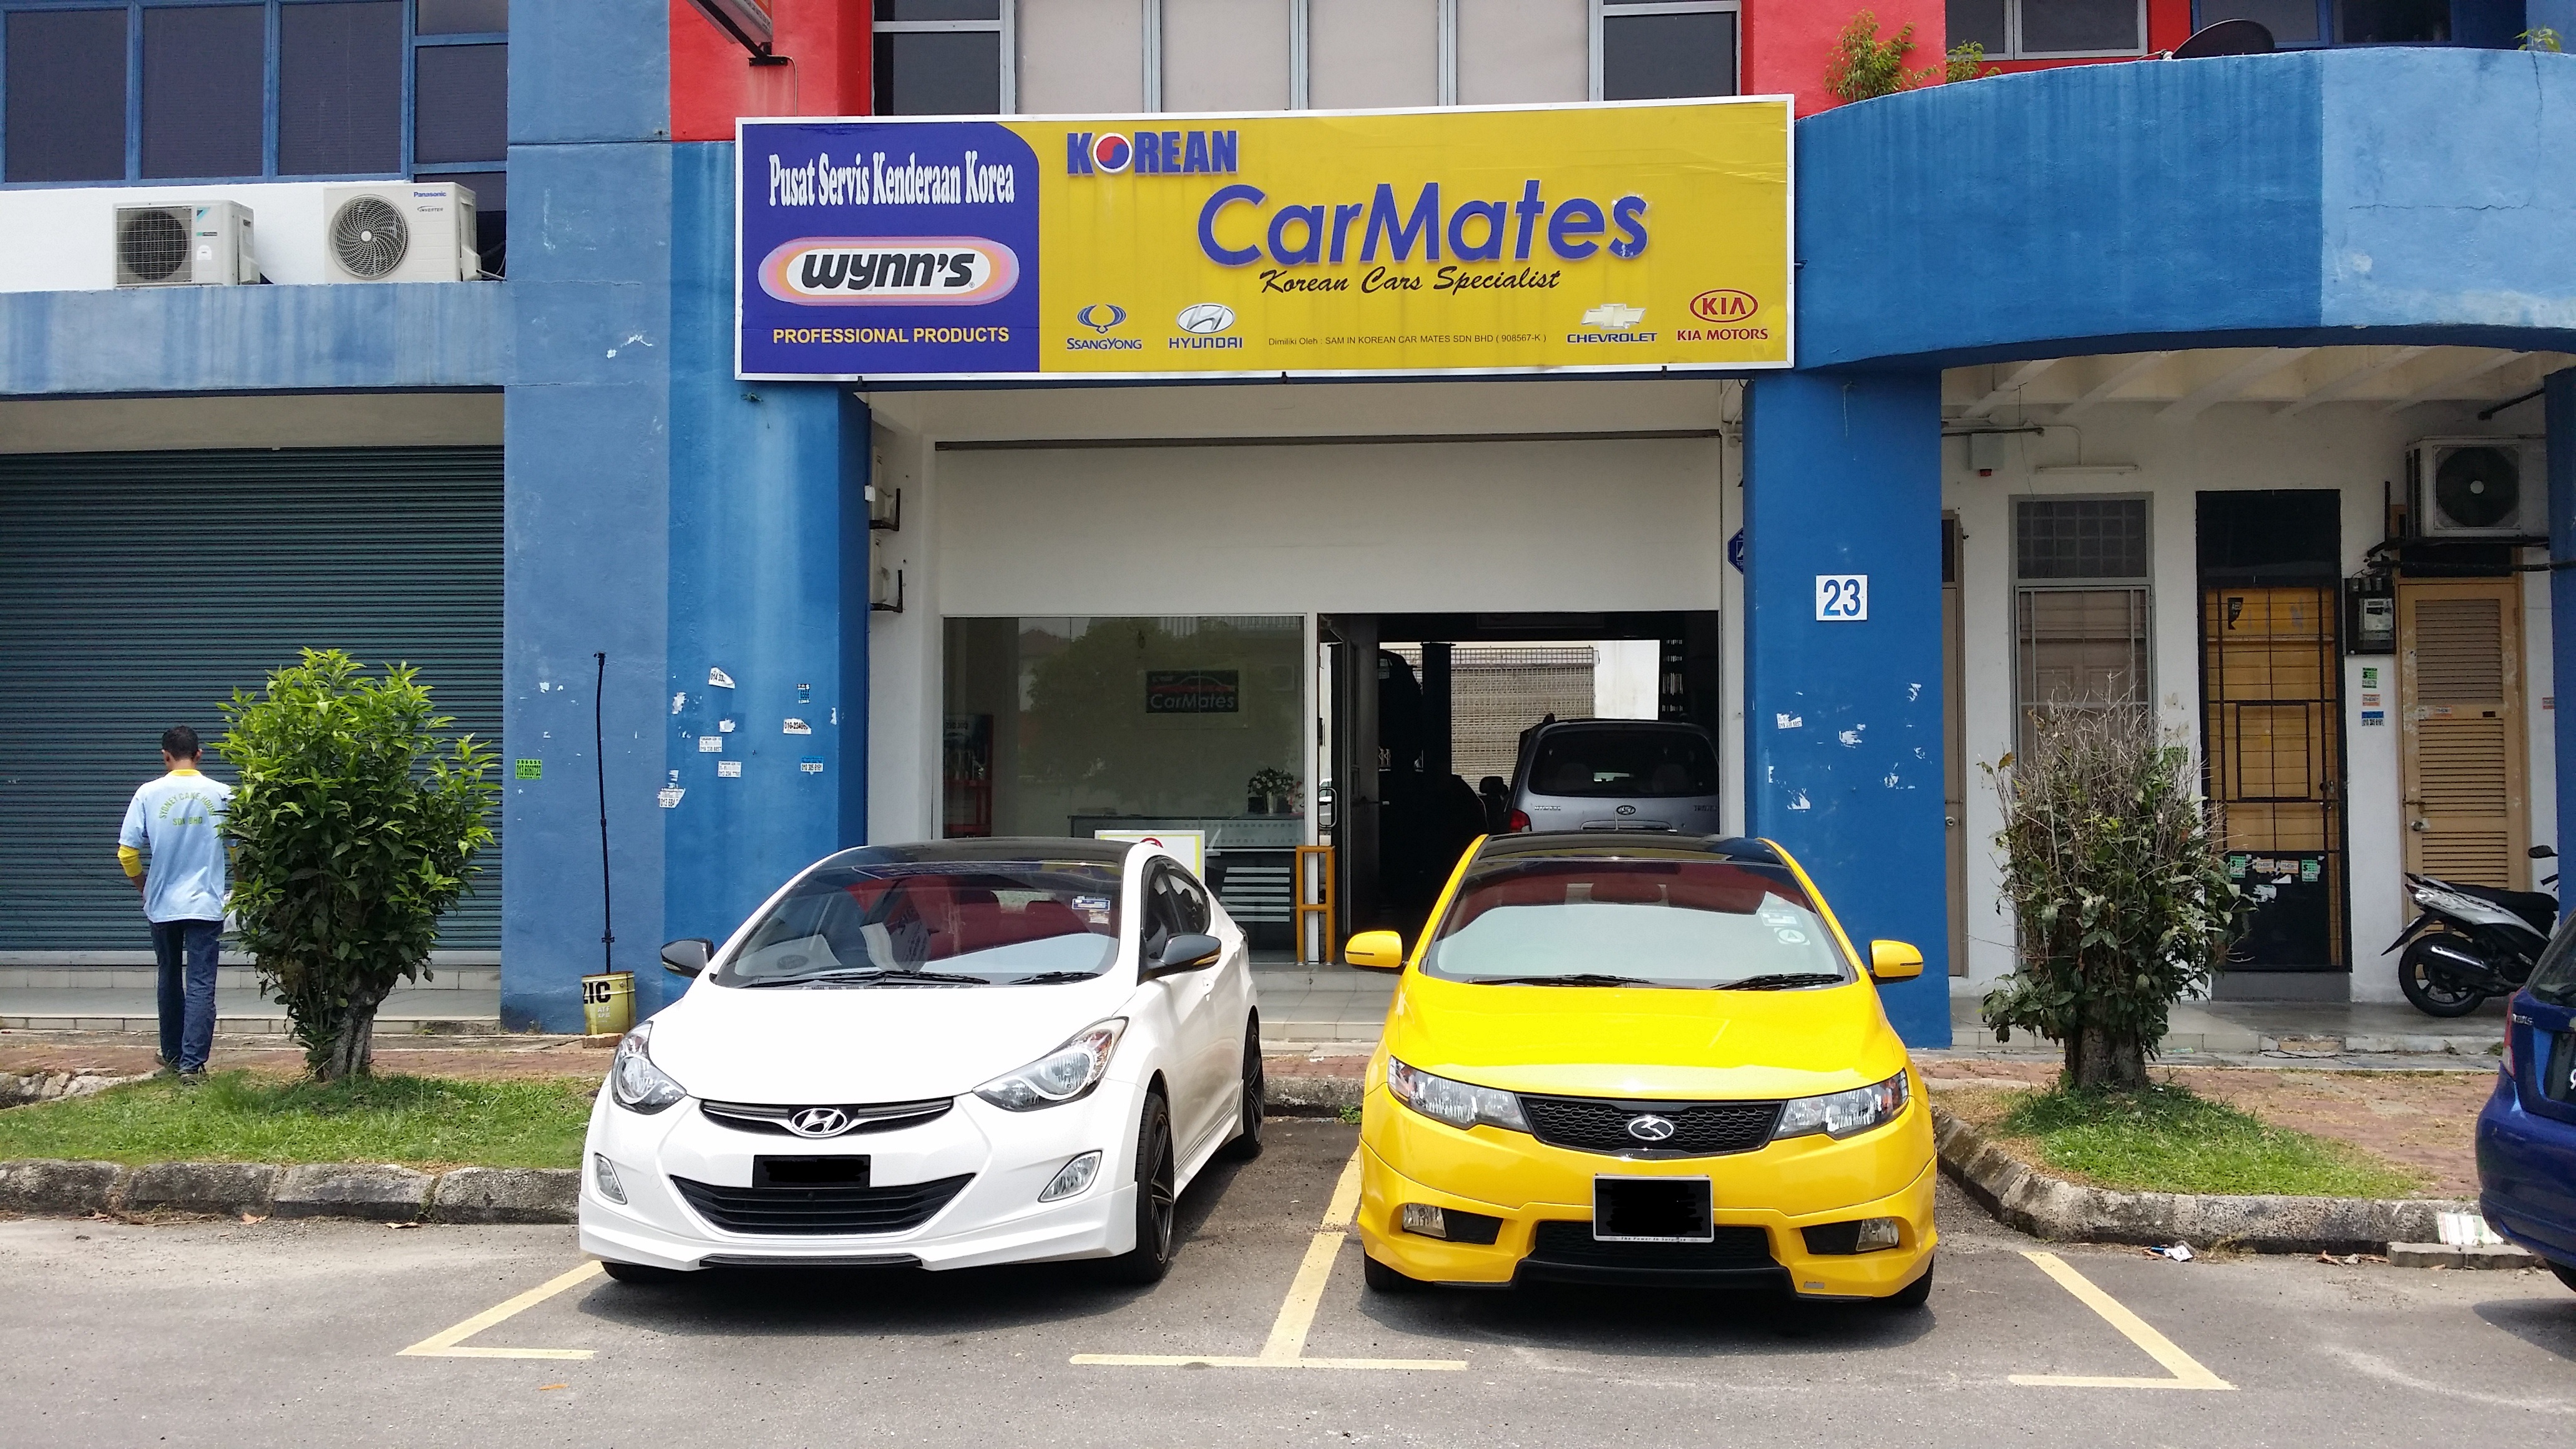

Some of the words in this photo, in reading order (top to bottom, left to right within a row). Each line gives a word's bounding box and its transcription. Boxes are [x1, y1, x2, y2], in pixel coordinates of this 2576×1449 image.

[1068, 129, 1238, 176] KOREAN
[769, 154, 815, 207] Pusat
[817, 152, 869, 206] Servis
[873, 152, 961, 205] Kenderaan
[965, 150, 1015, 204] Korea
[1197, 179, 1648, 267] CarMates
[1259, 270, 1350, 294] Korean
[1361, 266, 1423, 294] Cars
[1433, 266, 1561, 296] Specialist
[773, 328, 909, 344] PROFESSIONAL
[914, 326, 1010, 343] PRODUCTS
[1169, 337, 1244, 349] HYUNDAI
[1269, 338, 1297, 346] Dimiliki
[1359, 336, 1396, 344] KOREAN
[1475, 334, 1494, 343] BHD
[1501, 334, 1541, 343] 908567-K
[1567, 332, 1658, 343] CHEVROLET
[1677, 330, 1702, 341] KIA
[1706, 328, 1769, 340] MOTORS
[1823, 579, 1861, 617] 23
[1150, 693, 1235, 709] CarMates
[178, 791, 201, 801] CAKE
